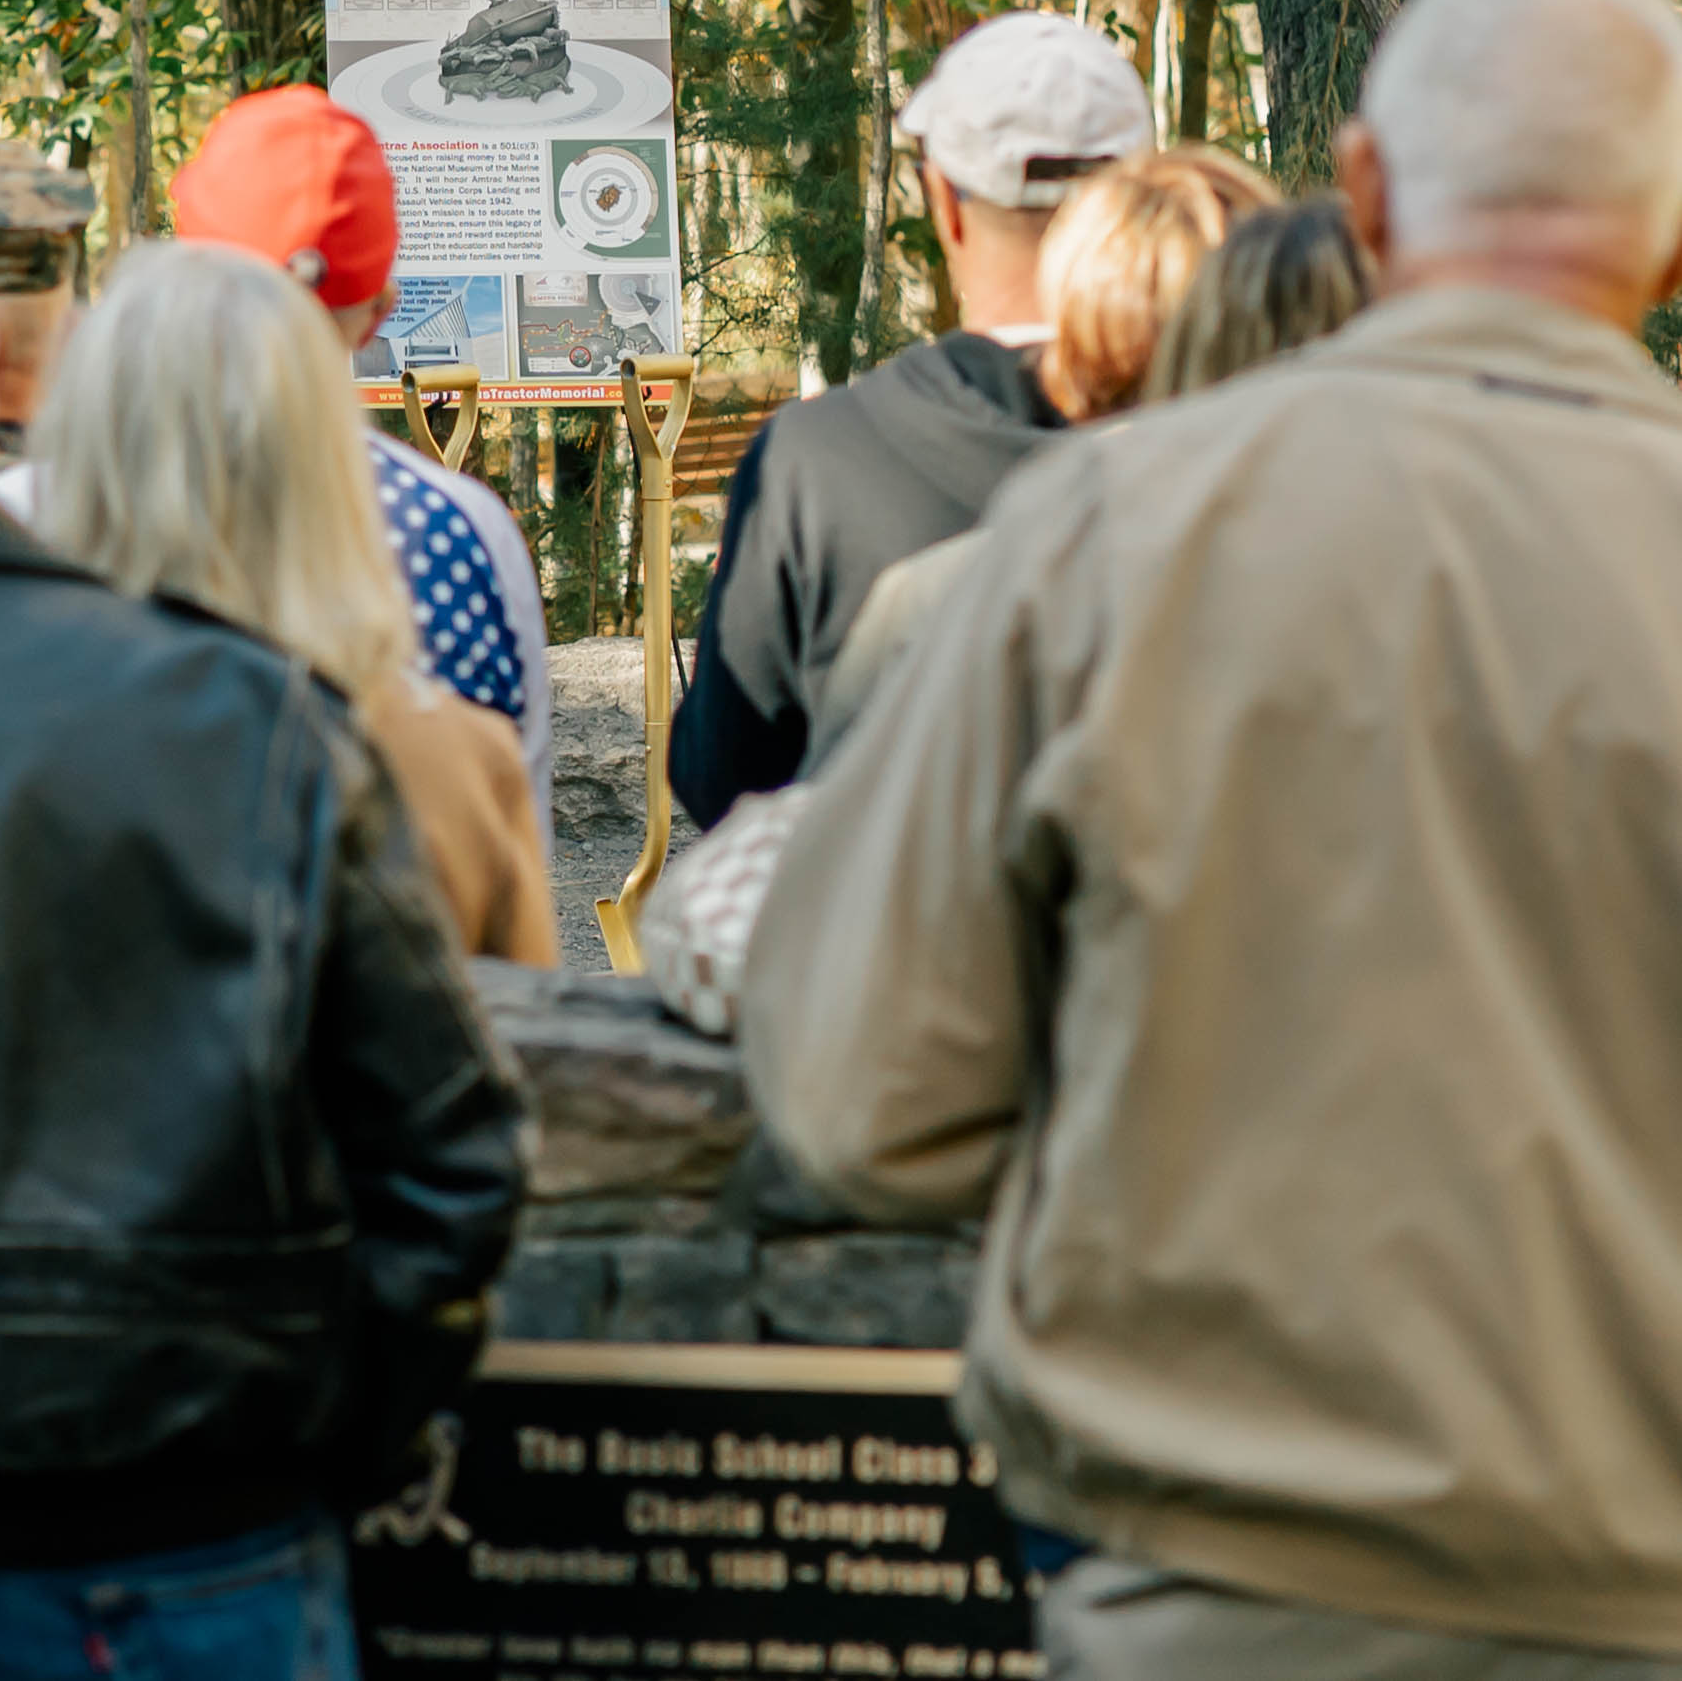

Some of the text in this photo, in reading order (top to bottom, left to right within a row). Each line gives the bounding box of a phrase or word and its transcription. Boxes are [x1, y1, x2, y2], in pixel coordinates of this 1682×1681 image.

[411, 141, 479, 150] Association
[482, 142, 489, 150] is
[500, 142, 539, 150] 501(c)(3)
[436, 154, 464, 163] raising
[468, 155, 494, 163] money
[510, 153, 531, 161] build
[448, 164, 483, 172] Museum
[426, 175, 440, 183] will
[444, 175, 469, 183] honor
[472, 175, 502, 183] Amtrac
[506, 175, 540, 183] Marines
[405, 186, 422, 194] U.S.
[425, 186, 454, 194] Marine
[458, 186, 482, 195] Corps
[487, 186, 521, 195] Landing
[525, 186, 541, 194] and
[429, 197, 463, 205] Vehicles
[490, 197, 513, 205] 1942.
[491, 208, 524, 216] educate
[423, 220, 457, 228] Marines,
[505, 220, 531, 228] legacy
[533, 219, 541, 227] of
[405, 231, 445, 240] recognize
[465, 230, 492, 238] reward
[495, 230, 542, 239] exceptional
[508, 241, 543, 249] hardship
[398, 253, 430, 261] Marines
[432, 253, 447, 261] and
[449, 253, 467, 261] their
[469, 252, 501, 260] families
[516, 1426, 585, 1474] The
[712, 1430, 843, 1482] School
[852, 1435, 960, 1486] Class
[625, 1489, 947, 1553] Charlie Company
[469, 1540, 637, 1587] September
[826, 1550, 969, 1604] February
